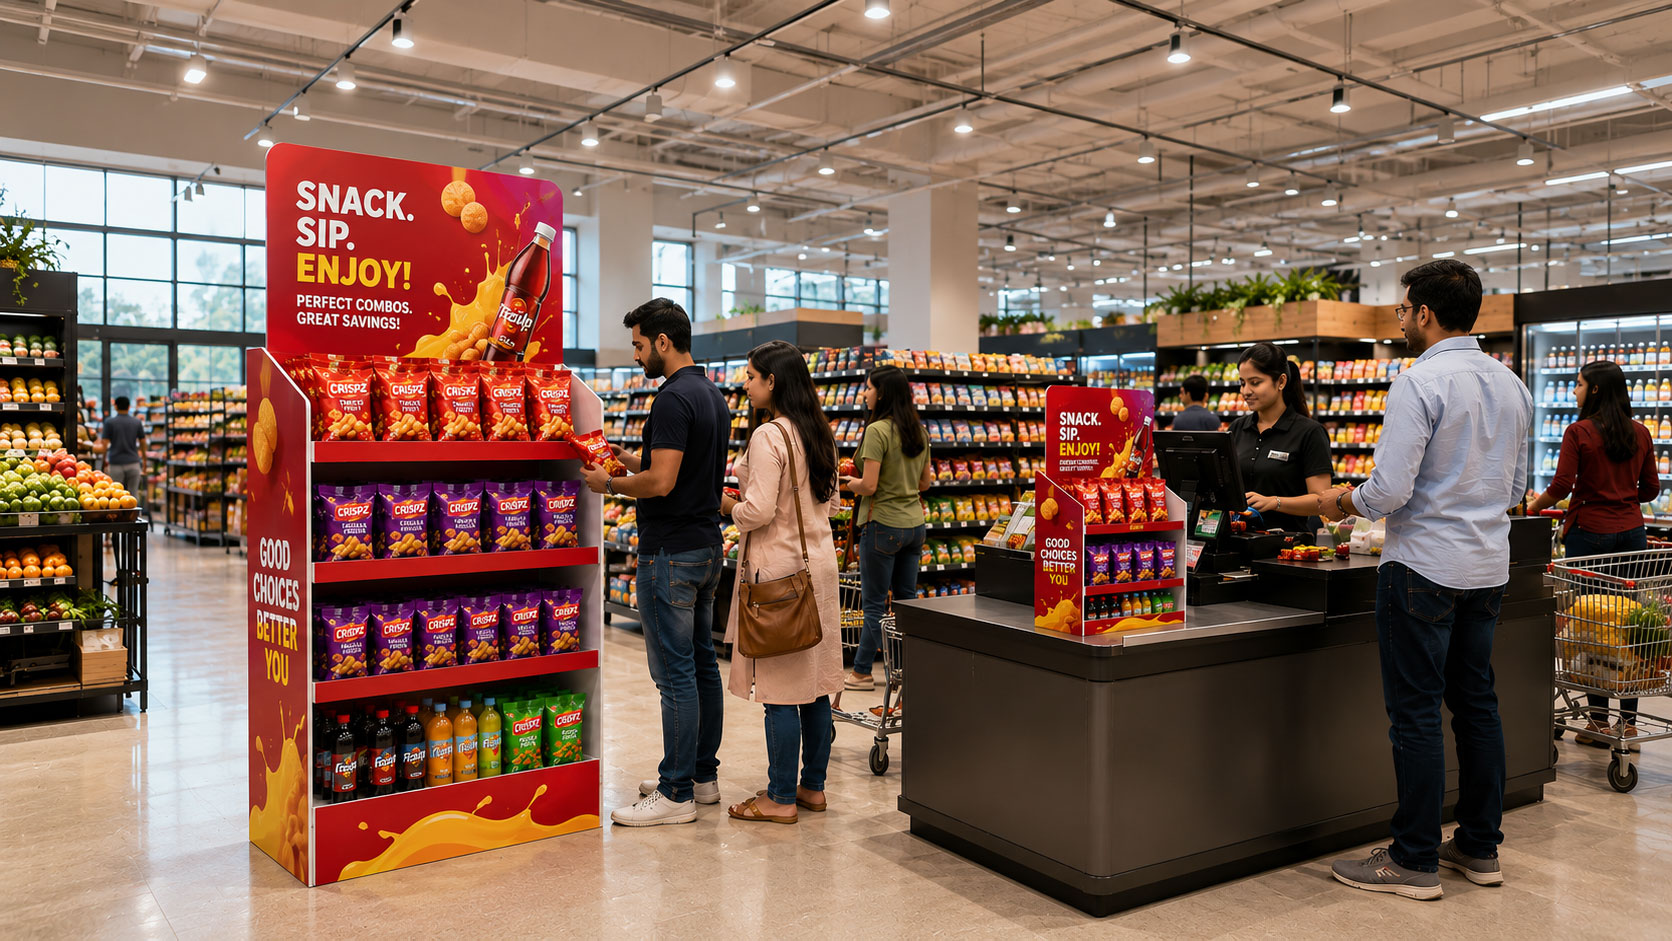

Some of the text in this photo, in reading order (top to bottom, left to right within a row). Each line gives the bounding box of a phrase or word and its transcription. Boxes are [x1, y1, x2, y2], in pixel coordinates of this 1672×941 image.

[296, 181, 414, 222] SNACK.
[296, 216, 355, 251] SIP.
[297, 252, 411, 291] ENJOY!
[296, 294, 413, 314] PERFECT COMBOS.
[296, 311, 400, 330] GREAT SAVINGS!
[330, 383, 368, 394] CRISPZ
[1059, 412, 1101, 426] SNACK.
[1059, 427, 1080, 441] SIP.
[1059, 442, 1100, 456] ENJOY!
[337, 505, 370, 517] CRISPZ
[394, 503, 425, 515] CRISPZ
[1045, 537, 1070, 548] GOOD
[259, 537, 290, 571] GOOD
[1040, 549, 1077, 561] CHOICES
[1049, 574, 1069, 586] YOU
[253, 572, 300, 612] CHOICES
[256, 609, 298, 652] BETTER
[265, 647, 289, 687] YOU
